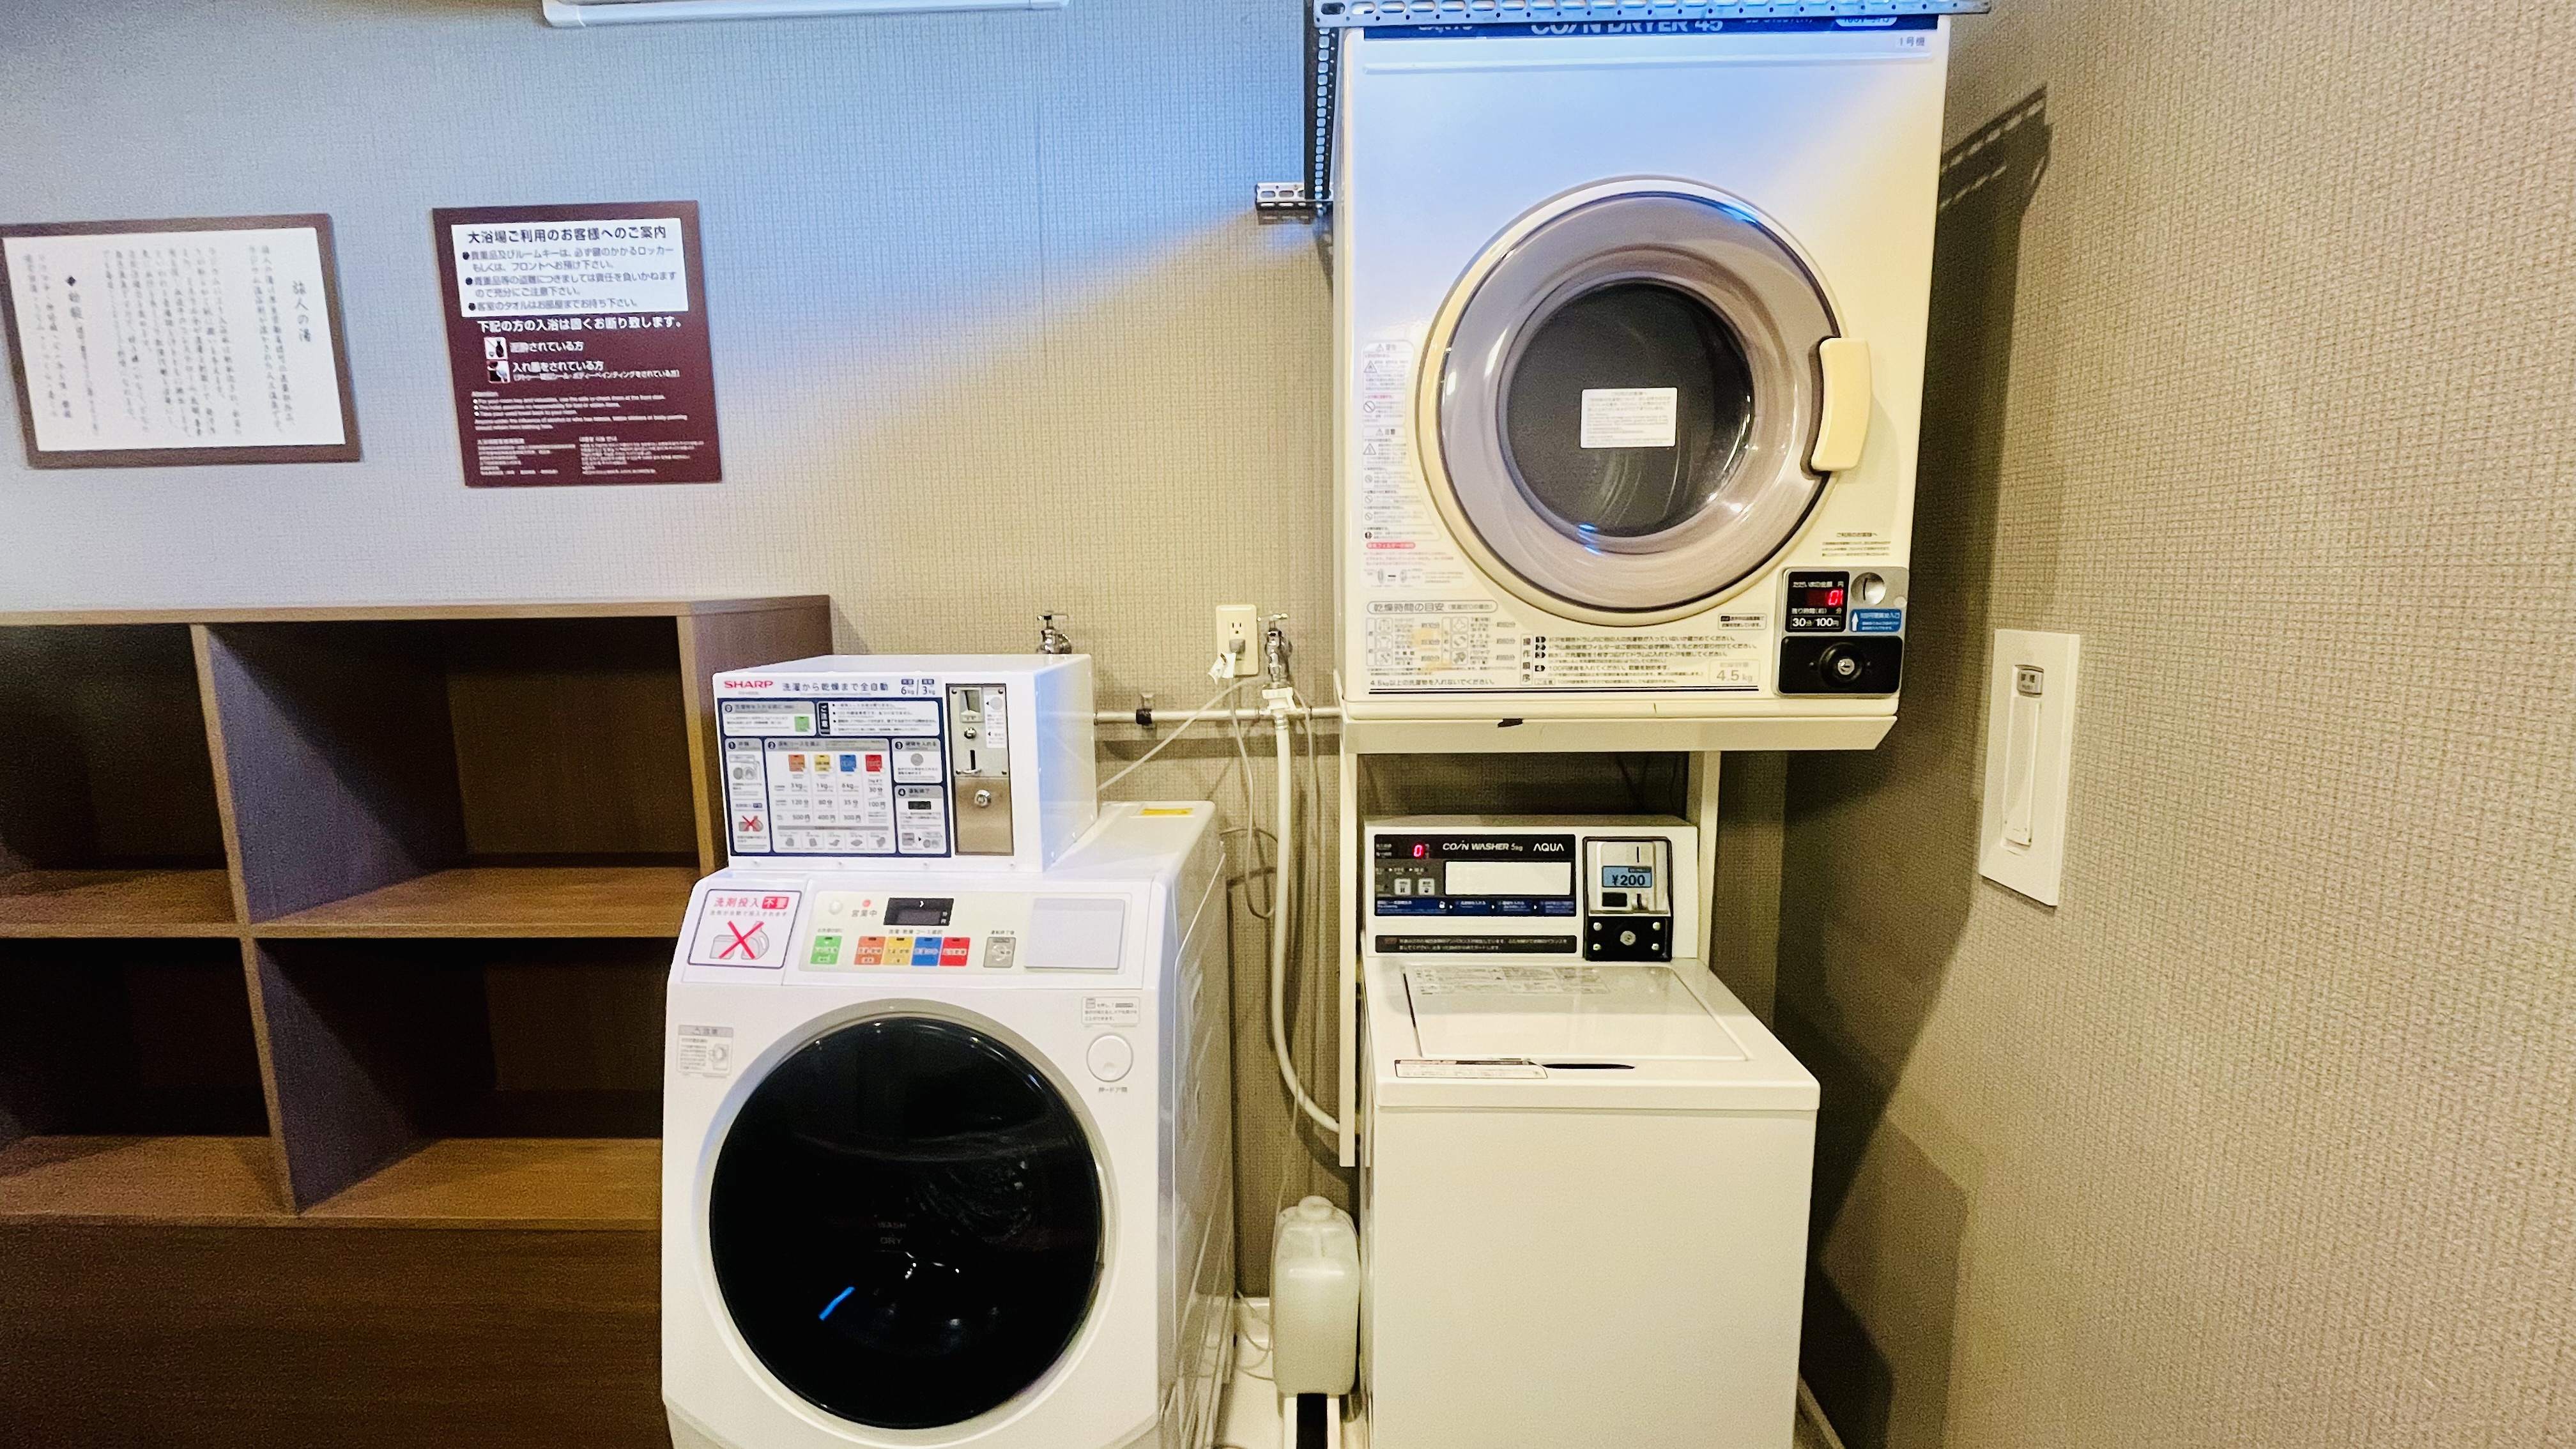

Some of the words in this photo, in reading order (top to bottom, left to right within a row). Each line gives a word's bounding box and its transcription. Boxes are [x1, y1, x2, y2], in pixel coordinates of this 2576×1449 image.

[468, 226, 666, 243] 大浴場ご利用のお客様へのご案内
[724, 680, 774, 689] SHARP
[783, 682, 888, 691] 洗濯から乾燥まで全自動
[1413, 844, 1423, 857] 0
[1443, 840, 1469, 851] COIN
[1533, 843, 1565, 852] AQUA
[1612, 875, 1646, 886] ¥200
